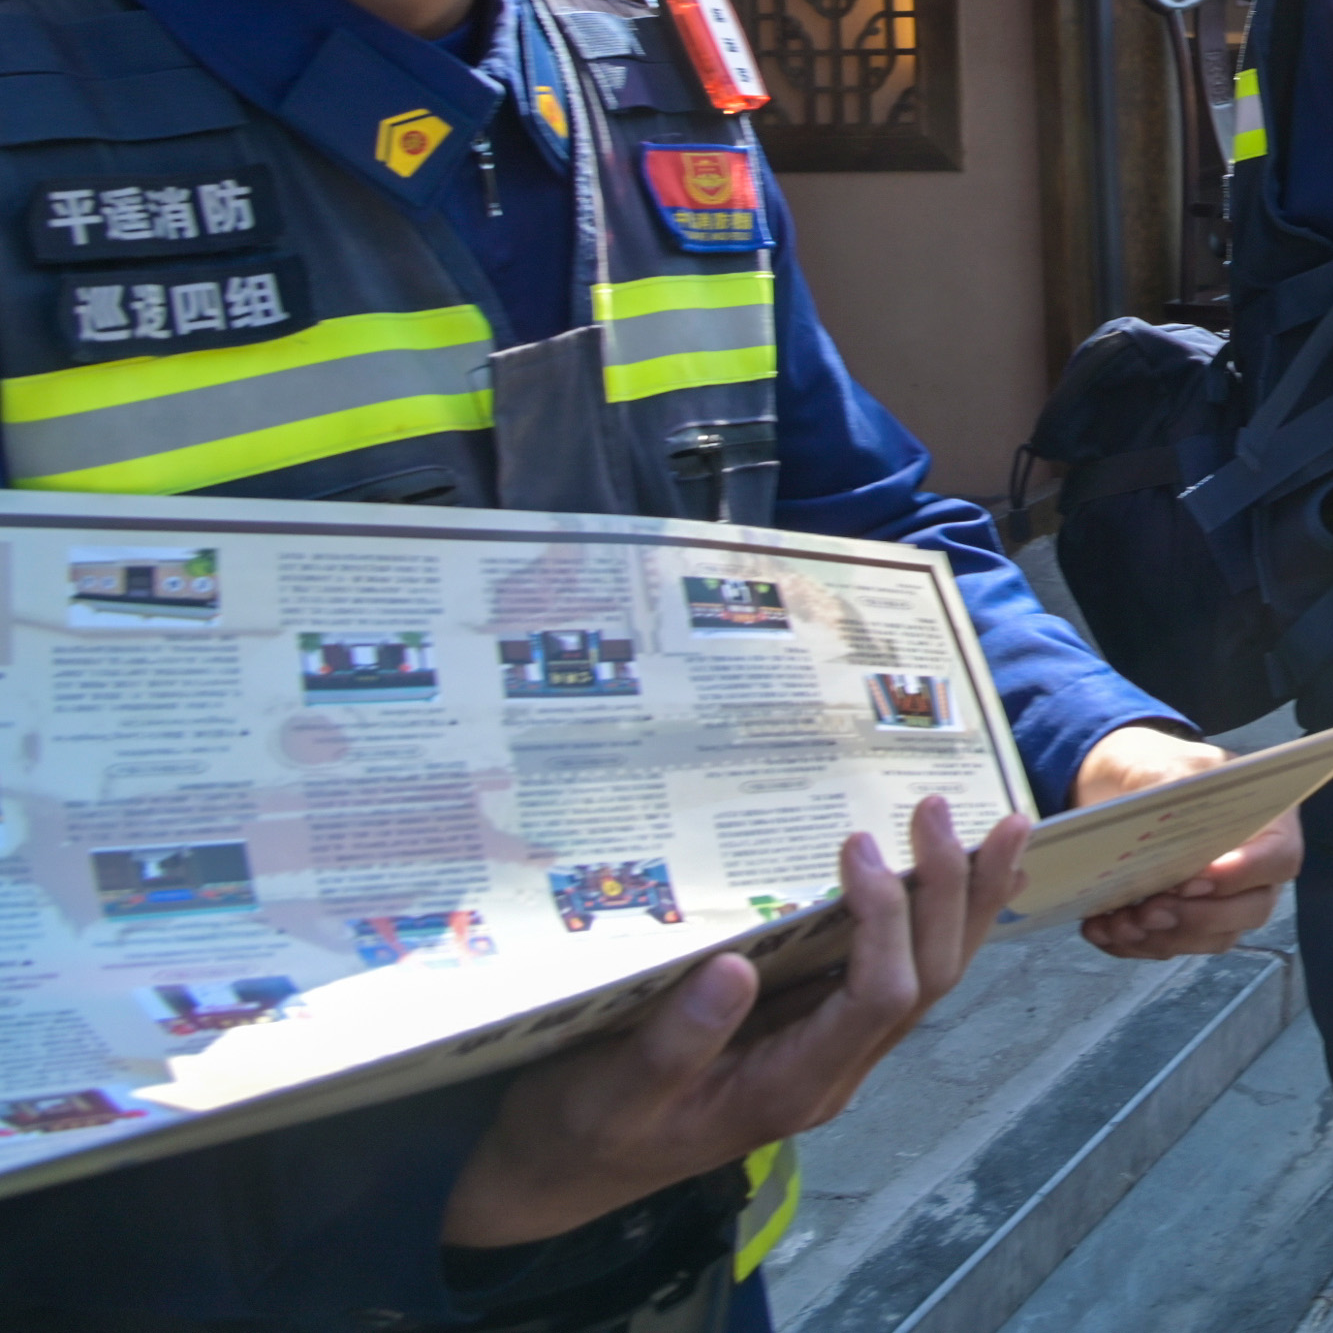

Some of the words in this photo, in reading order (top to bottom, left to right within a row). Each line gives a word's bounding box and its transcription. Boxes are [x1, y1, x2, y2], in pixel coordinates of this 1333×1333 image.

[46, 179, 256, 246] 平遥消防
[74, 272, 291, 342] 巡逻四组
